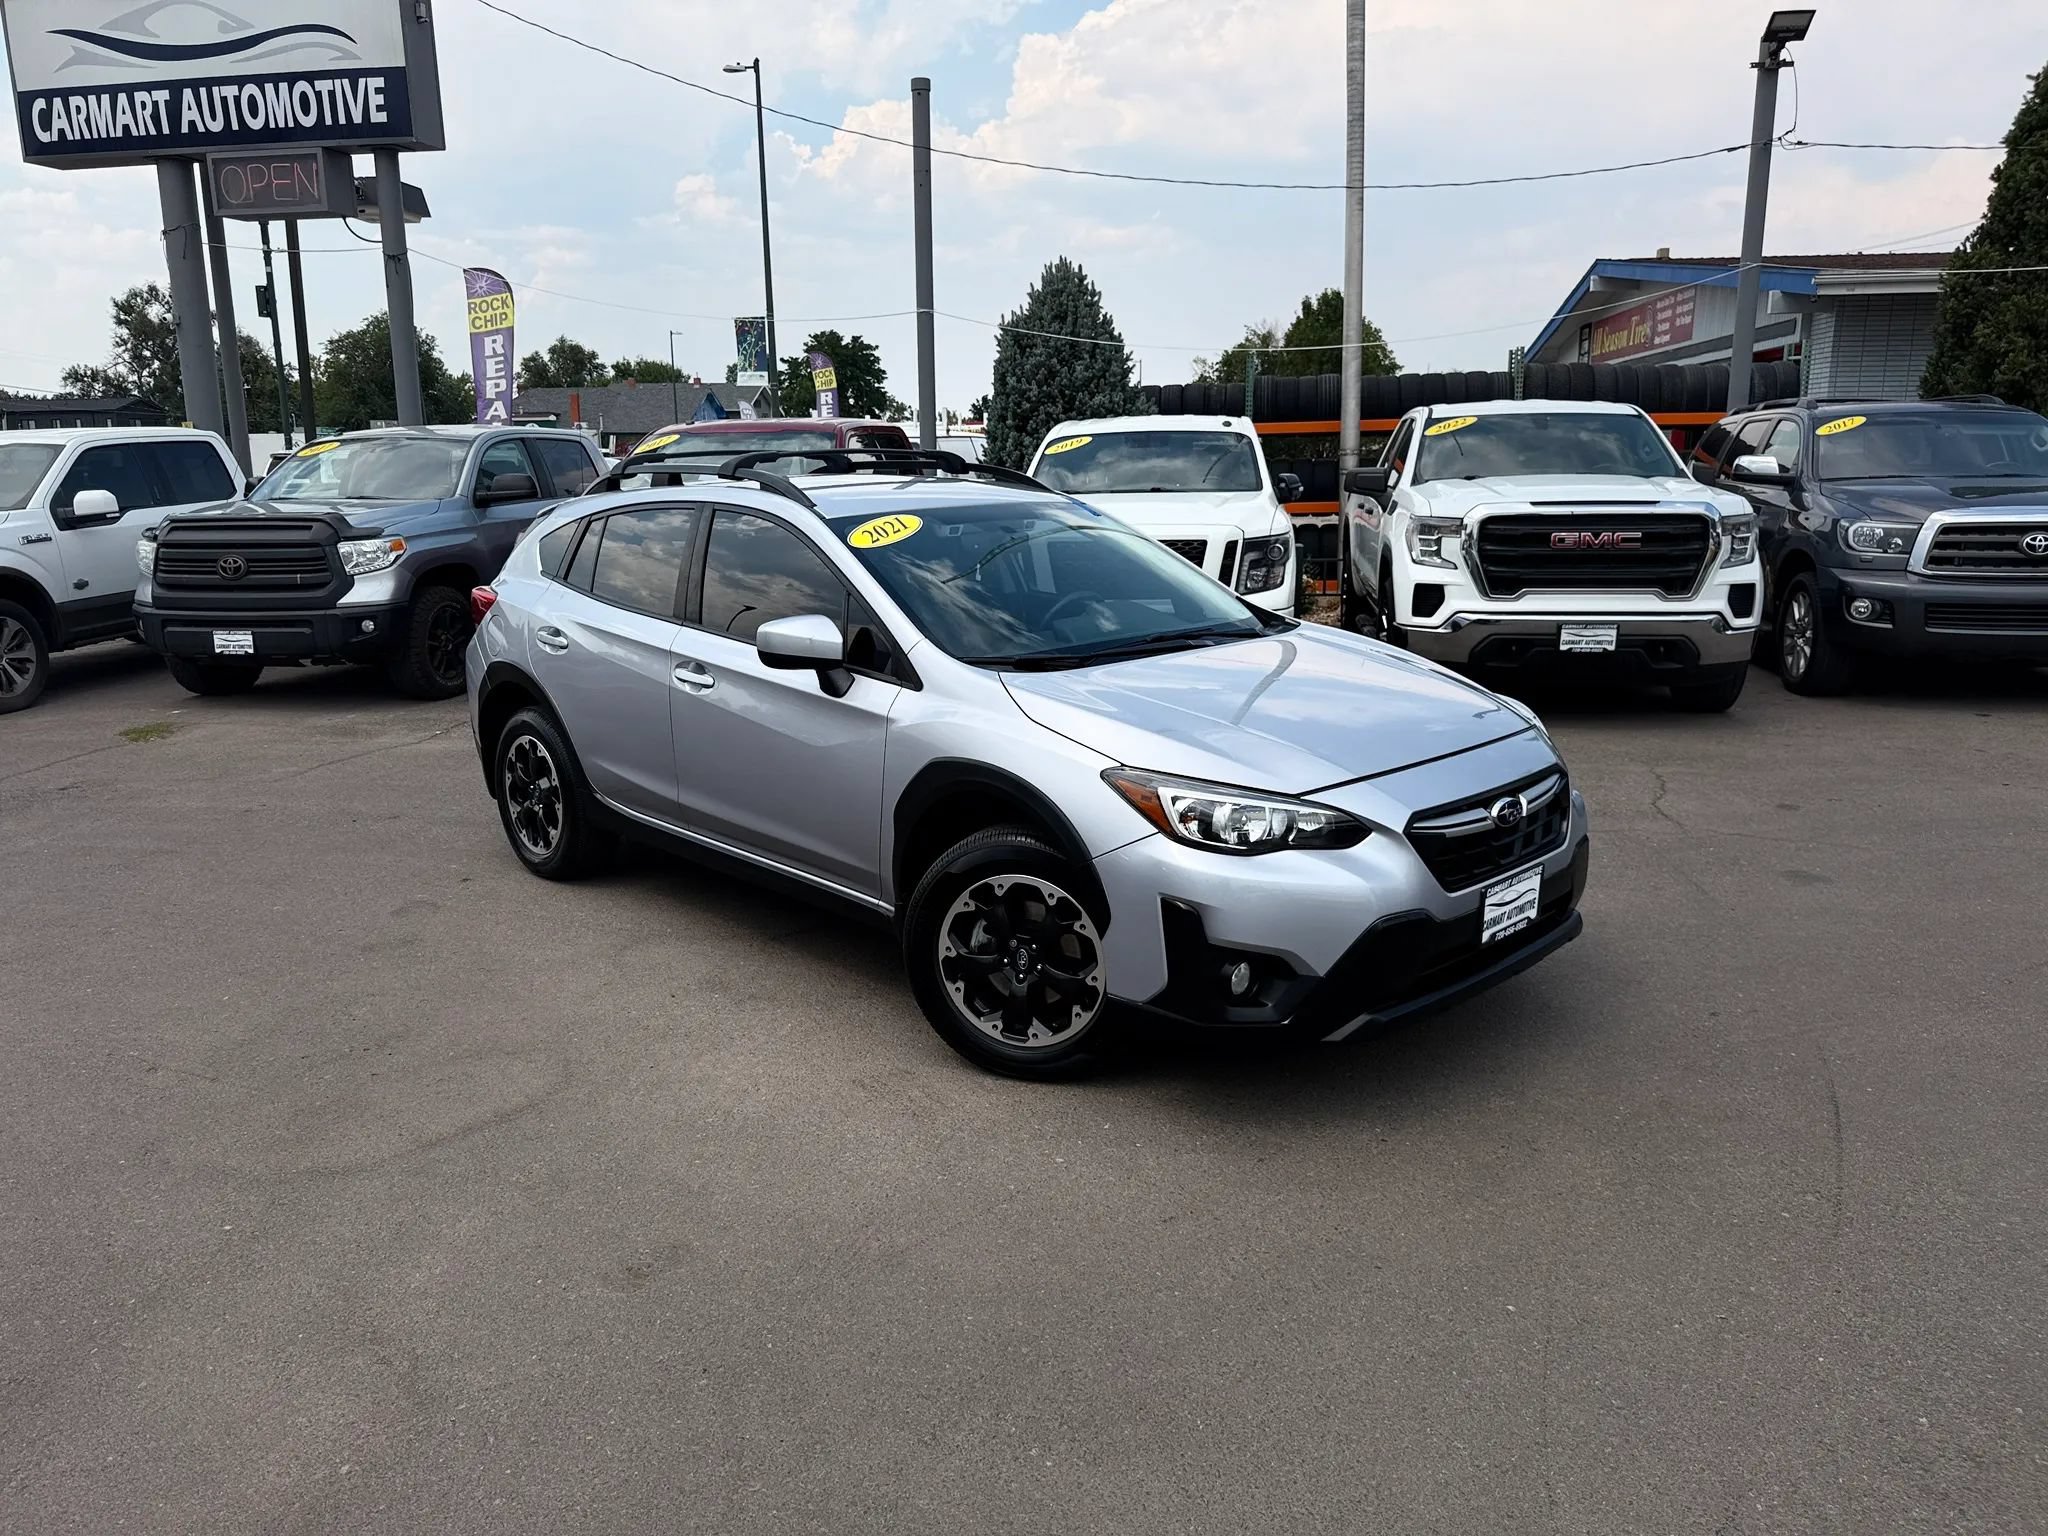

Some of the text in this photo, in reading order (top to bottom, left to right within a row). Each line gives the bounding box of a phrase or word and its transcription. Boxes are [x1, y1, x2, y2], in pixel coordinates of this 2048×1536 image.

[31, 77, 388, 143] CARMART AUTOMOTIVE
[220, 162, 320, 205] OPEN
[468, 294, 510, 315] ROCK
[471, 311, 509, 330] CHIP
[484, 333, 508, 425] REPA
[1435, 418, 1467, 432] 2022
[1824, 418, 1854, 433] 2017
[1054, 439, 1083, 451] 2019
[862, 517, 910, 543] 2021
[1551, 532, 1642, 549] GMC
[1486, 879, 1512, 897] CARMART
